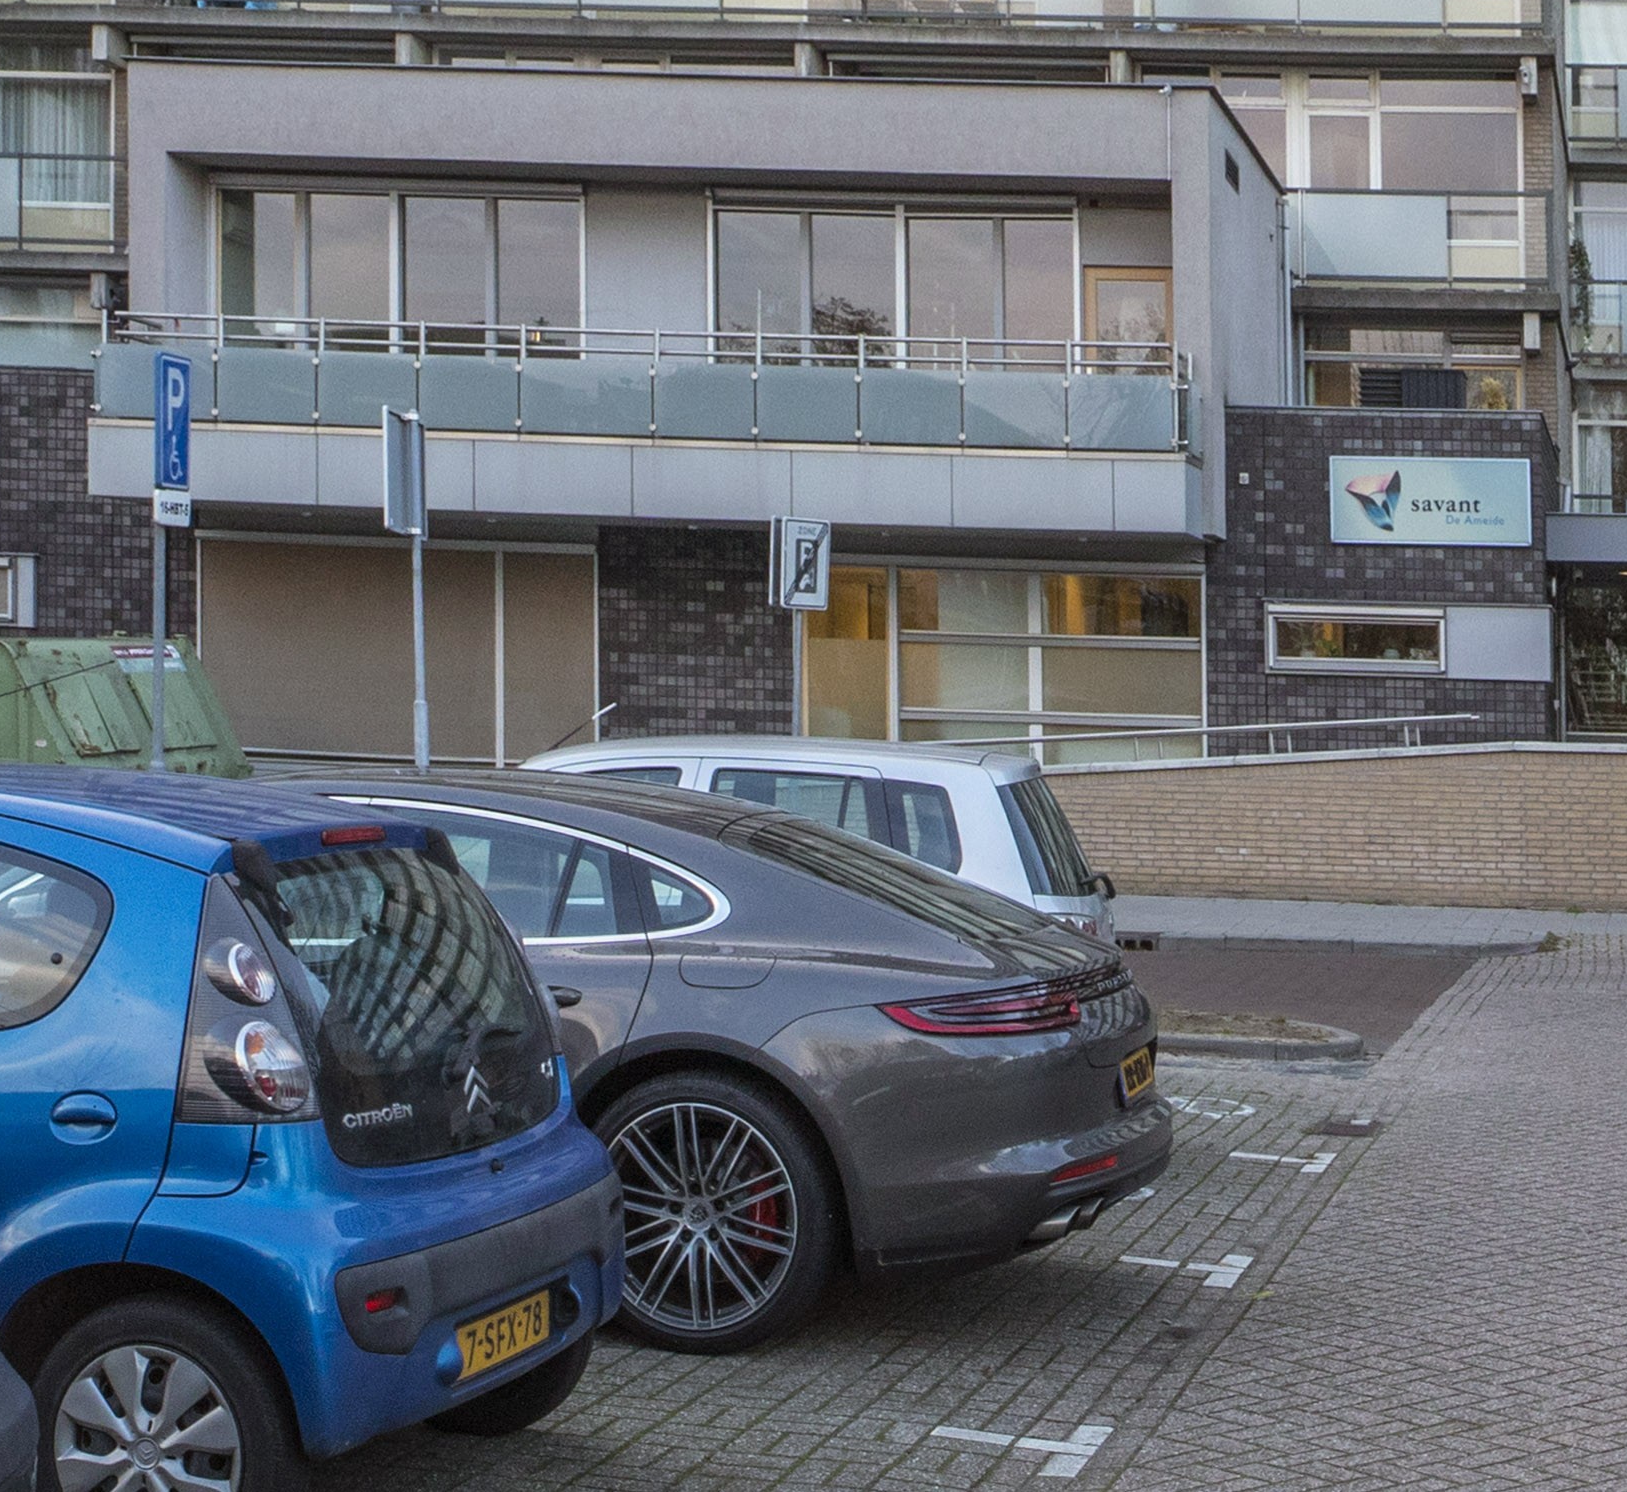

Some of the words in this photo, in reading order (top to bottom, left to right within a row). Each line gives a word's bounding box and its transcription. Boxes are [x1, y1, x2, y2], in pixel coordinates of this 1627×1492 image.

[167, 366, 185, 431] P
[1411, 498, 1481, 513] savant
[1445, 514, 1461, 525] De
[342, 1102, 413, 1129] CITROËN
[466, 1300, 542, 1369] 7-SFX-78
